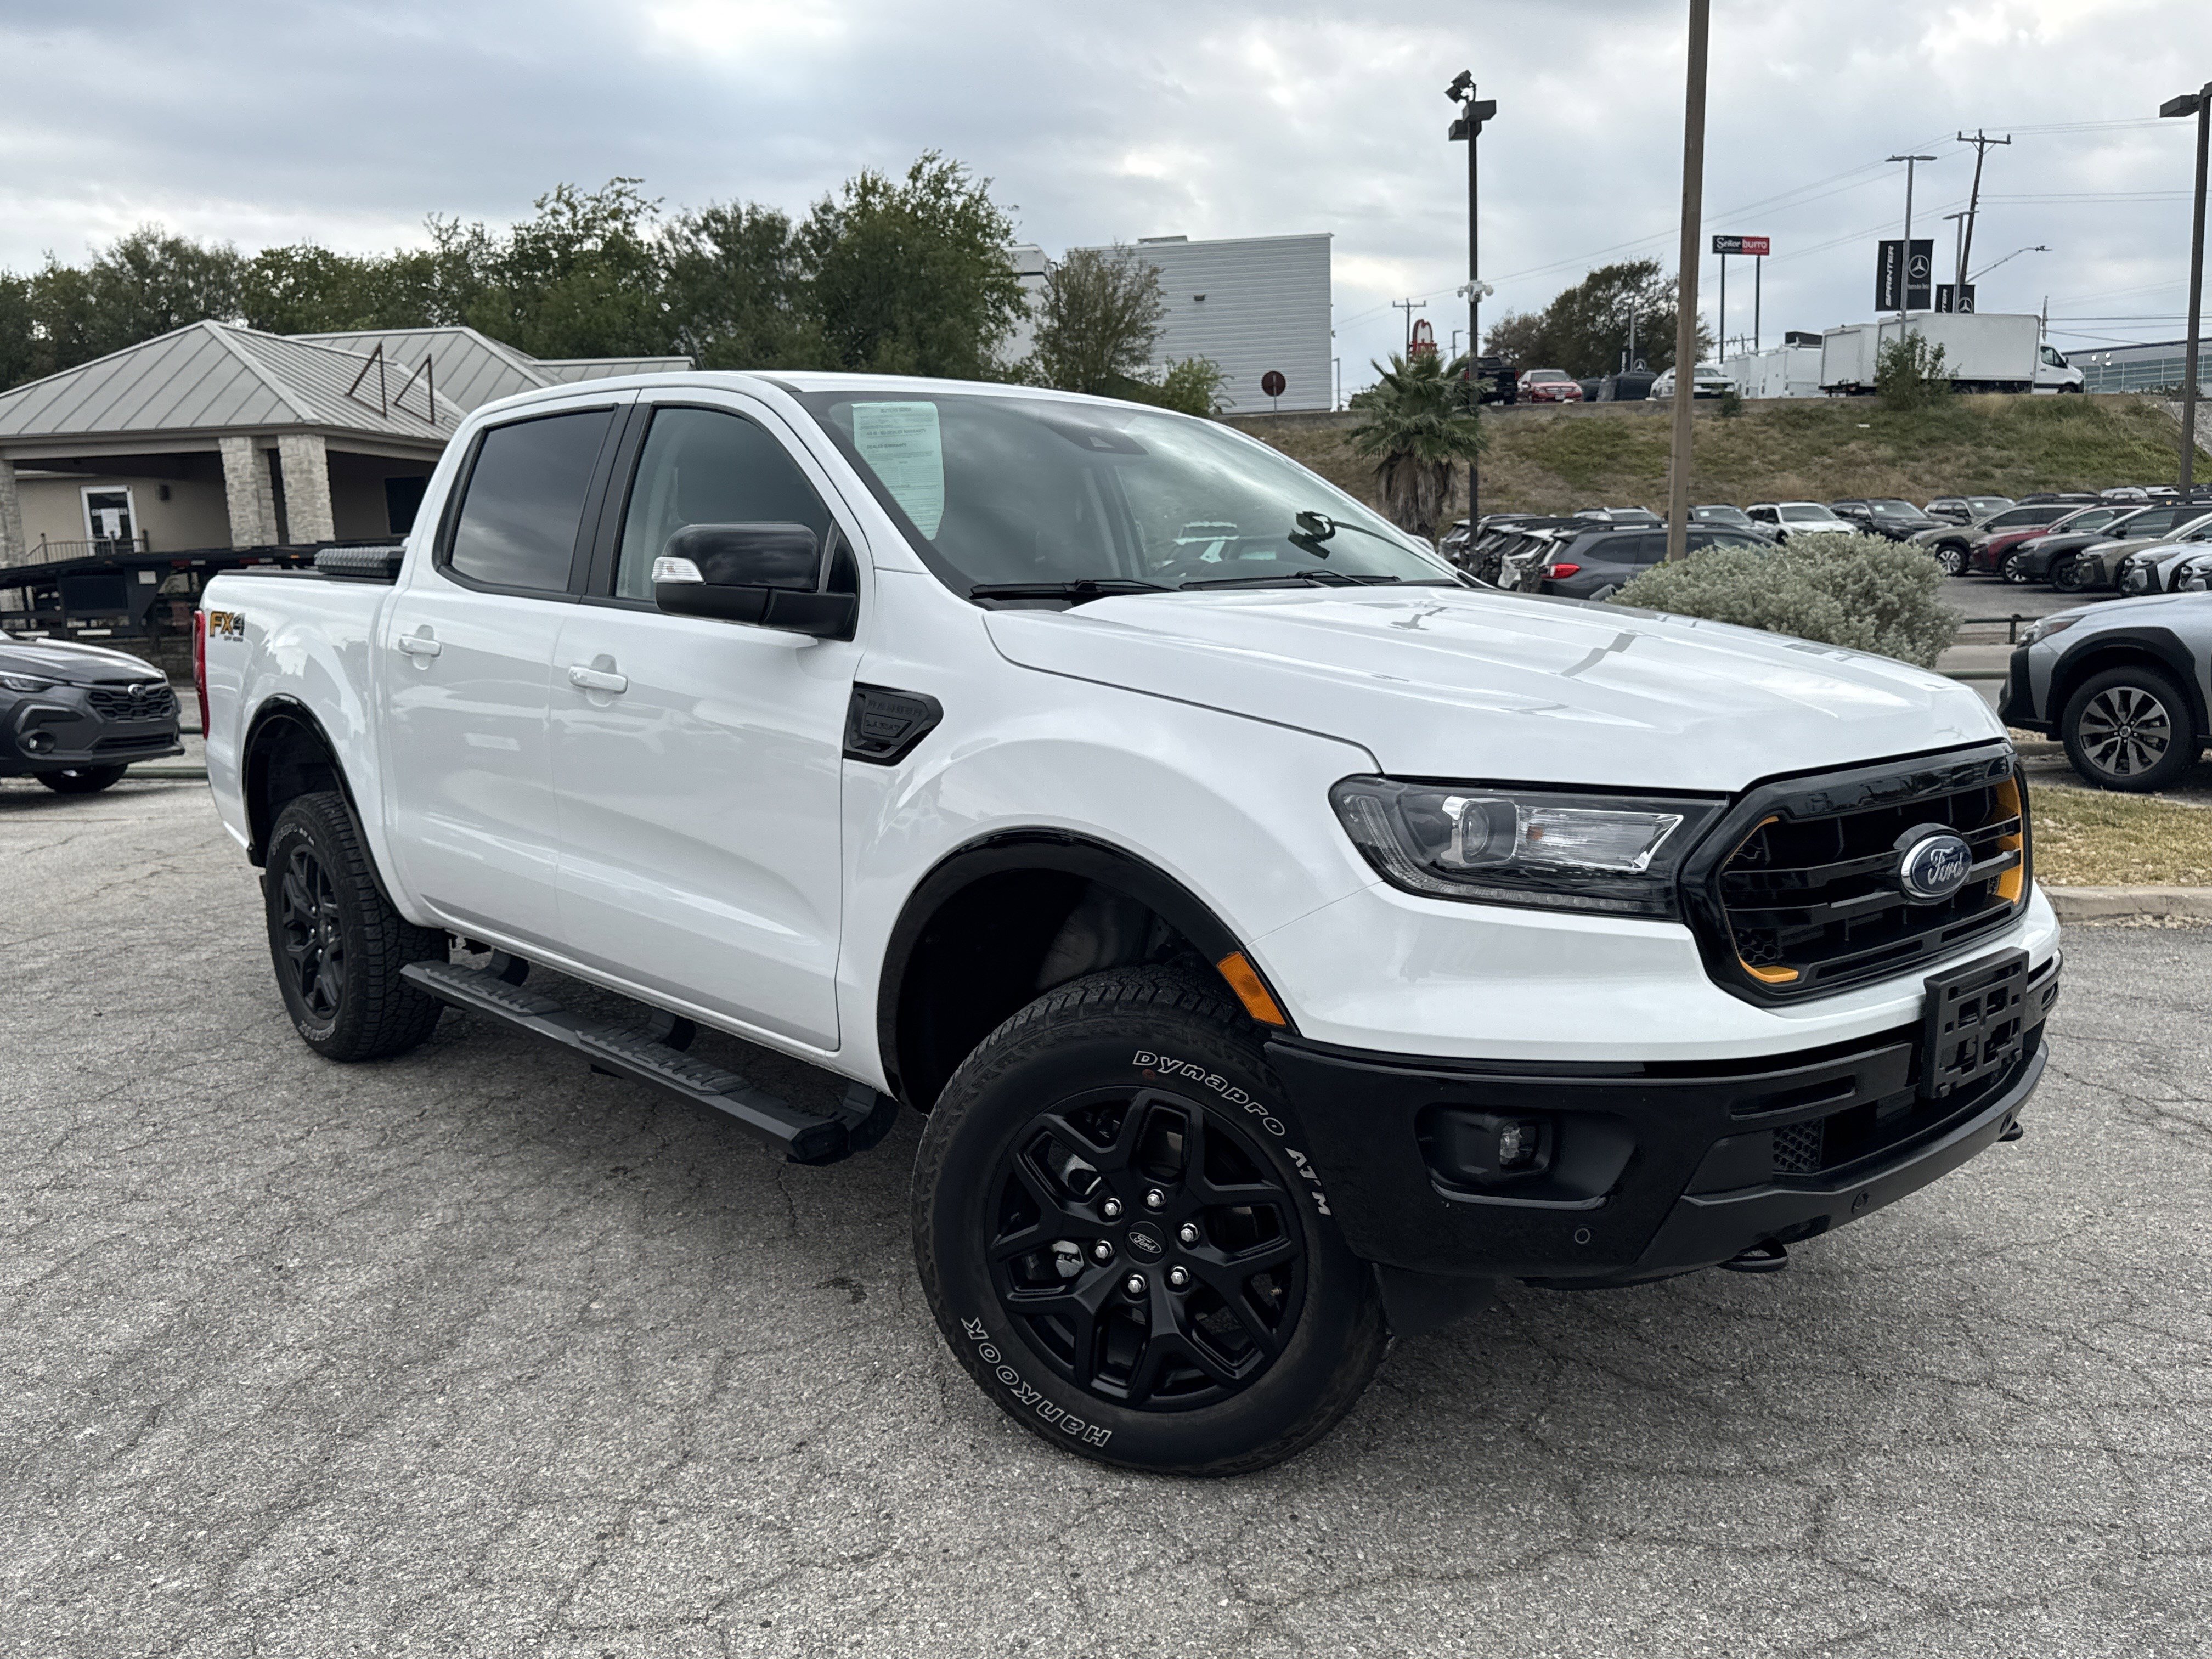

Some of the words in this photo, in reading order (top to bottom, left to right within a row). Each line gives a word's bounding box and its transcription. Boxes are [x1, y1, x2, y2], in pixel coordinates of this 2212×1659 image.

[1742, 239, 1768, 249] burro
[1885, 245, 1894, 307] SPRINTER
[210, 611, 245, 637] FX4
[1927, 847, 1963, 885] Ford
[1132, 1050, 1285, 1136] Dynapro
[1133, 1235, 1156, 1251] Ford
